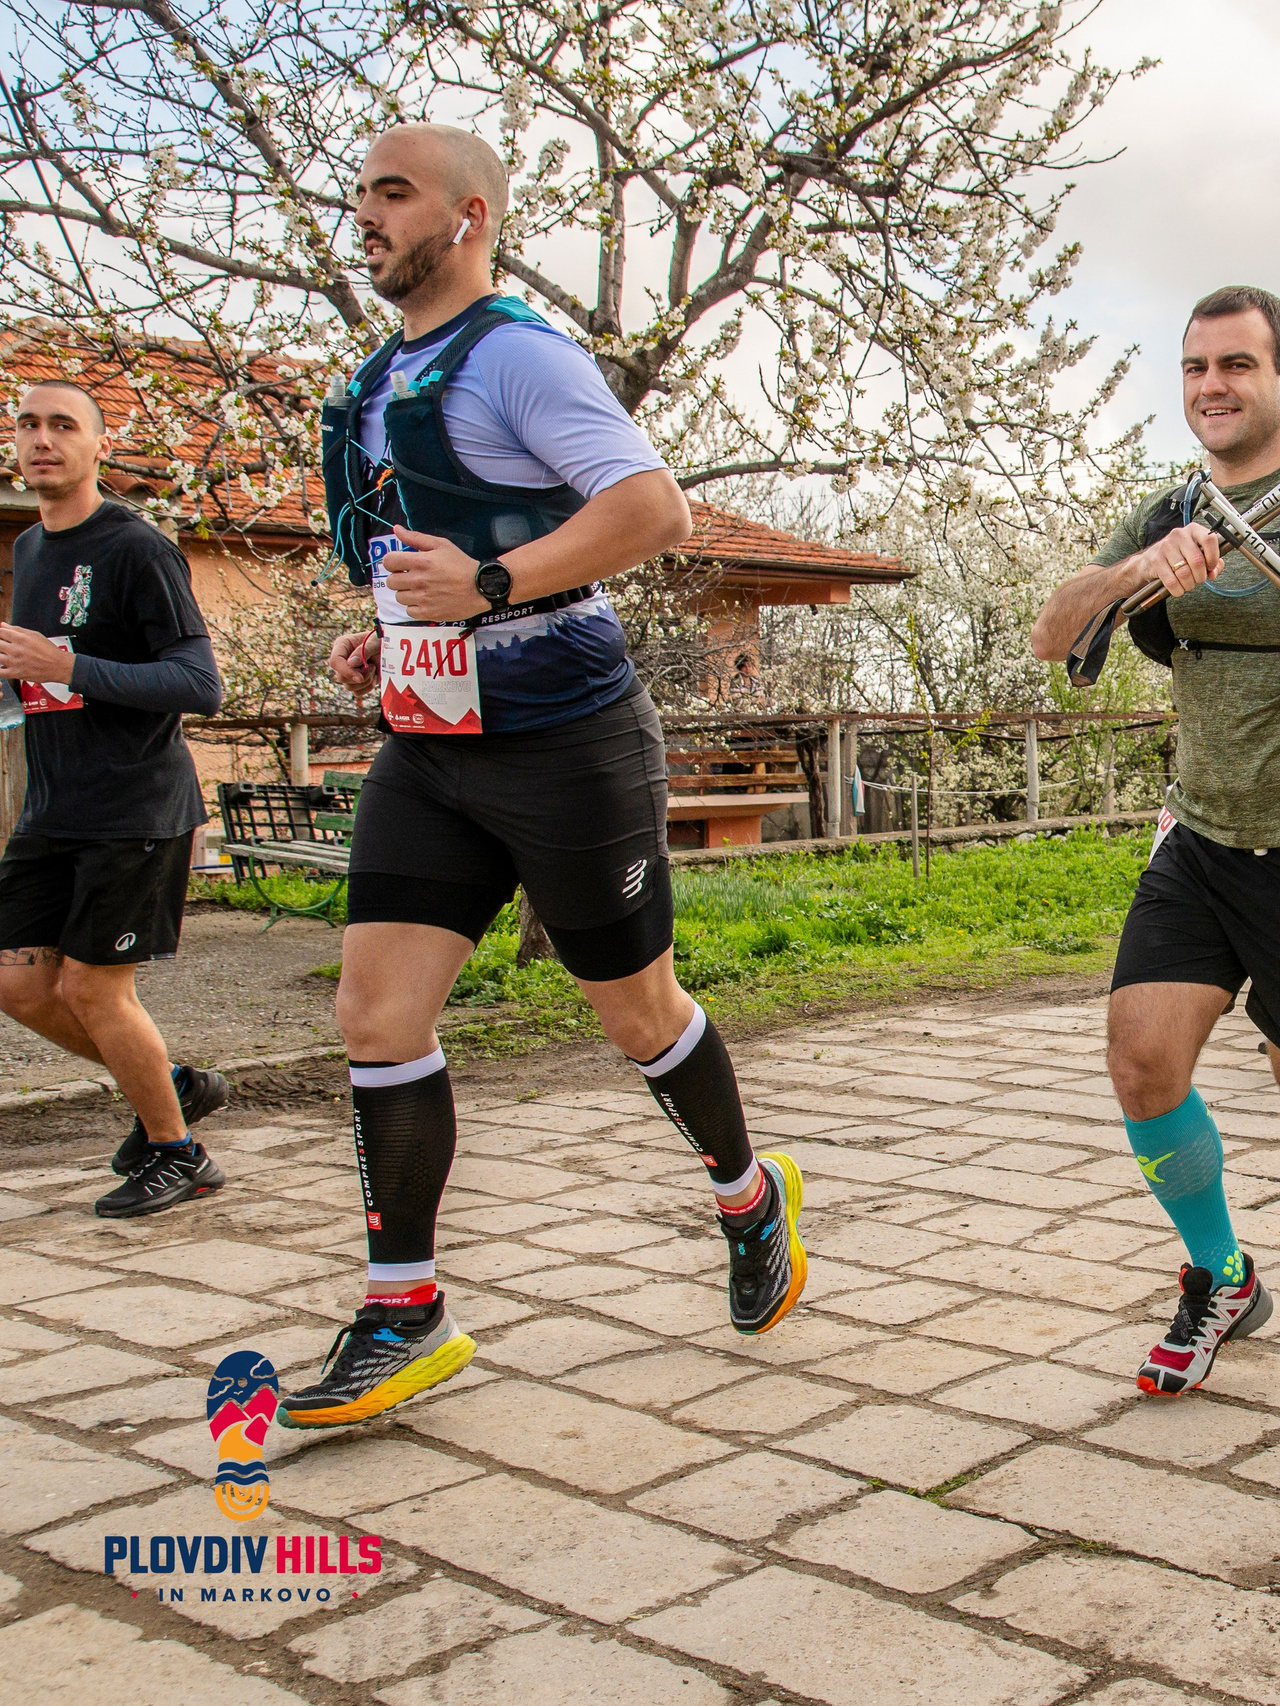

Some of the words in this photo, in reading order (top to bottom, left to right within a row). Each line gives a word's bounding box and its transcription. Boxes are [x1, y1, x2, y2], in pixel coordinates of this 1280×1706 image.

[400, 638, 468, 677] 2410
[421, 680, 472, 693] MARKOVO
[421, 692, 448, 705] TRAIL
[660, 1092, 704, 1152] COMPRESSPORT
[354, 1108, 374, 1207] COMPRESSPORT
